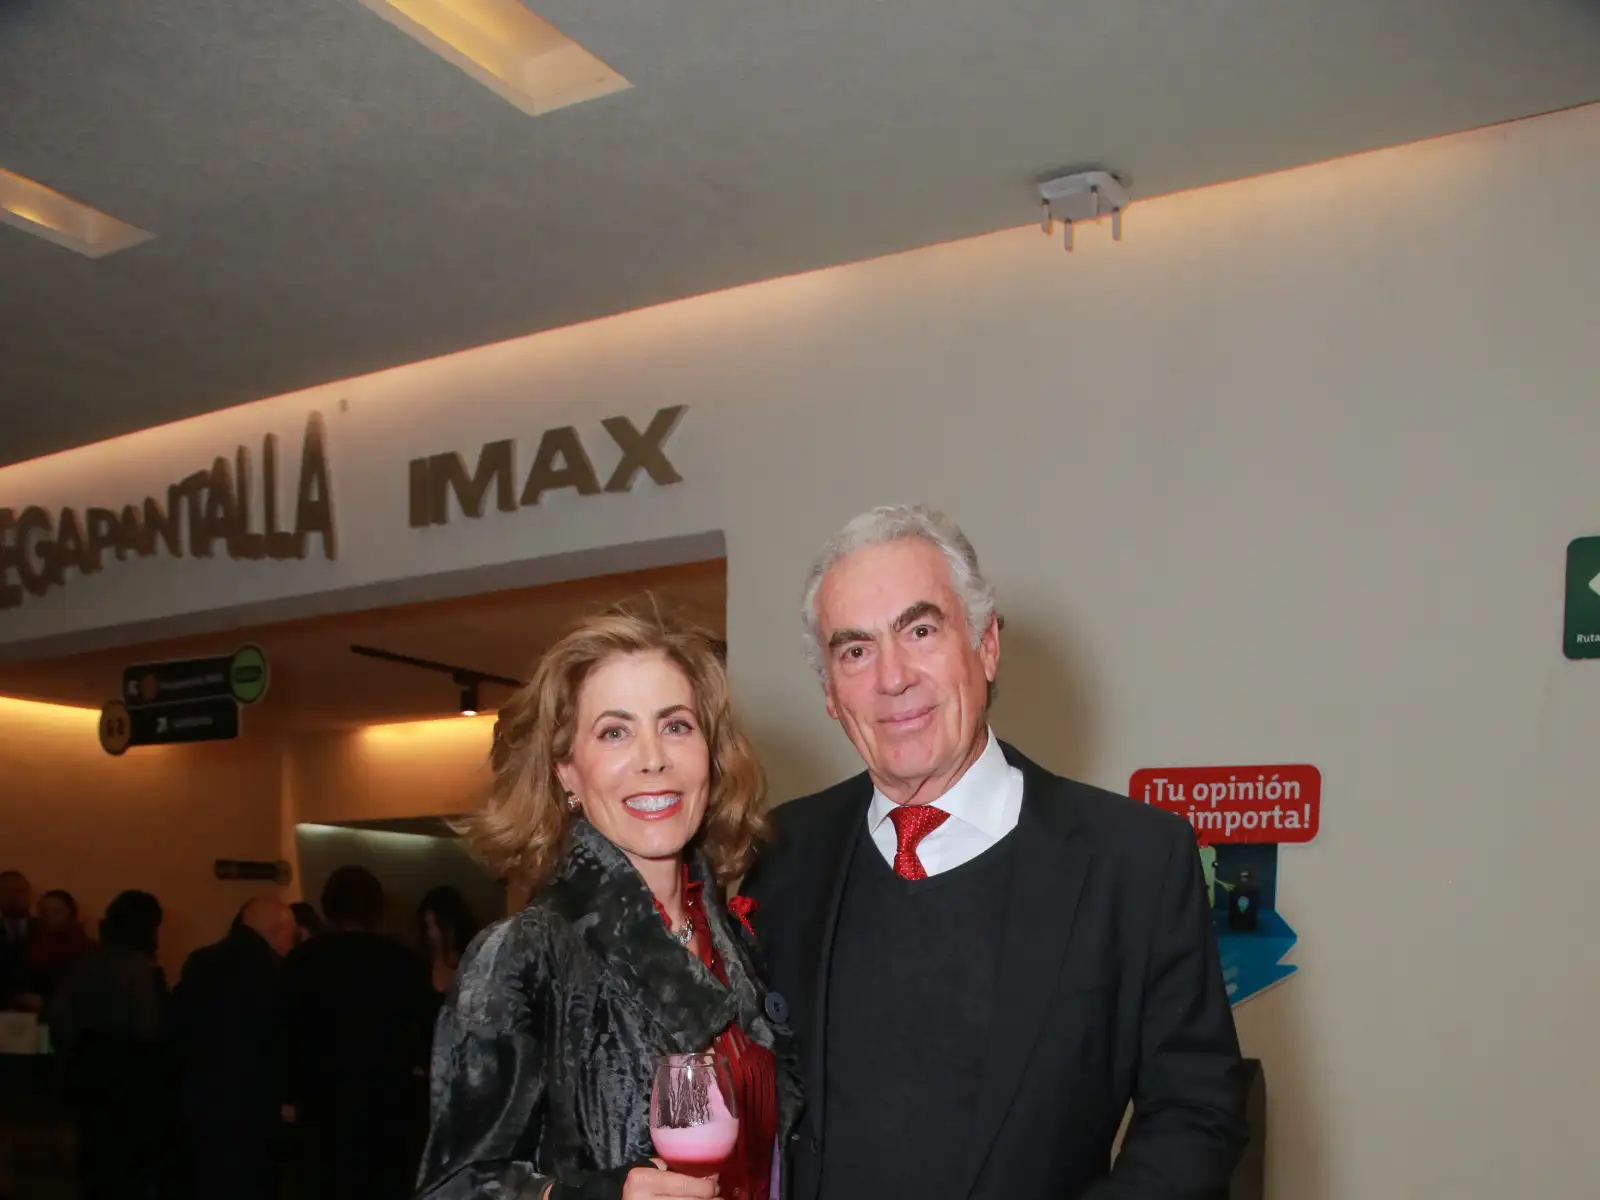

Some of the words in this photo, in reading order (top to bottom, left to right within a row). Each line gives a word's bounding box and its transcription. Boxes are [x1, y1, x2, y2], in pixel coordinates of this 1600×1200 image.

[409, 404, 689, 529] IMAX
[1144, 778, 1186, 805] ¡Tu
[1192, 774, 1300, 808] opinión
[1187, 803, 1311, 837] importa!
